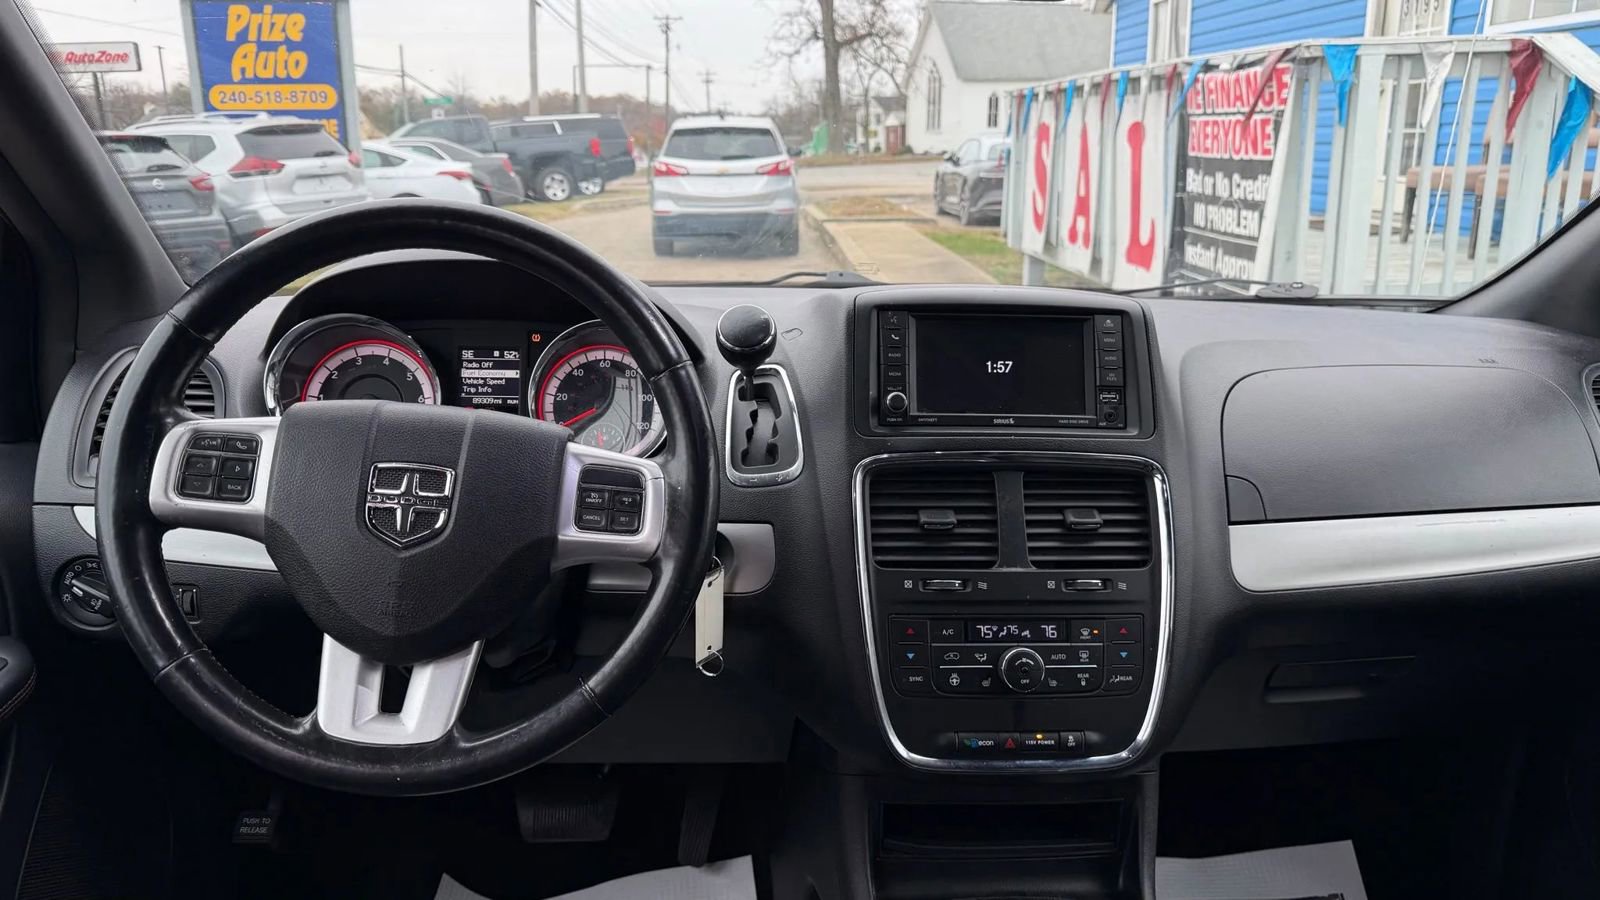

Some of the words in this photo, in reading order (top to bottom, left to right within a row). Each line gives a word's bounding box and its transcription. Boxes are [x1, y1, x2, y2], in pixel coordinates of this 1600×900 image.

[225, 5, 305, 41] Prize
[65, 51, 129, 64] AutoZone
[231, 43, 308, 82] Auto
[218, 90, 328, 105] 240-518-8709
[1203, 175, 1214, 196] or
[1215, 171, 1230, 199] No
[1194, 201, 1206, 227] NO
[1207, 204, 1259, 238] PROBLEM
[462, 350, 474, 358] SE
[383, 358, 390, 366] 4
[986, 361, 1013, 373] 1:57
[331, 371, 338, 379] 2
[407, 372, 413, 380] 5
[556, 393, 567, 401] 20
[63, 571, 75, 585] AUTO
[976, 625, 993, 638] 75
[1007, 625, 1019, 635] 75
[1040, 625, 1057, 638] 76
[240, 826, 268, 834] RELEASE
